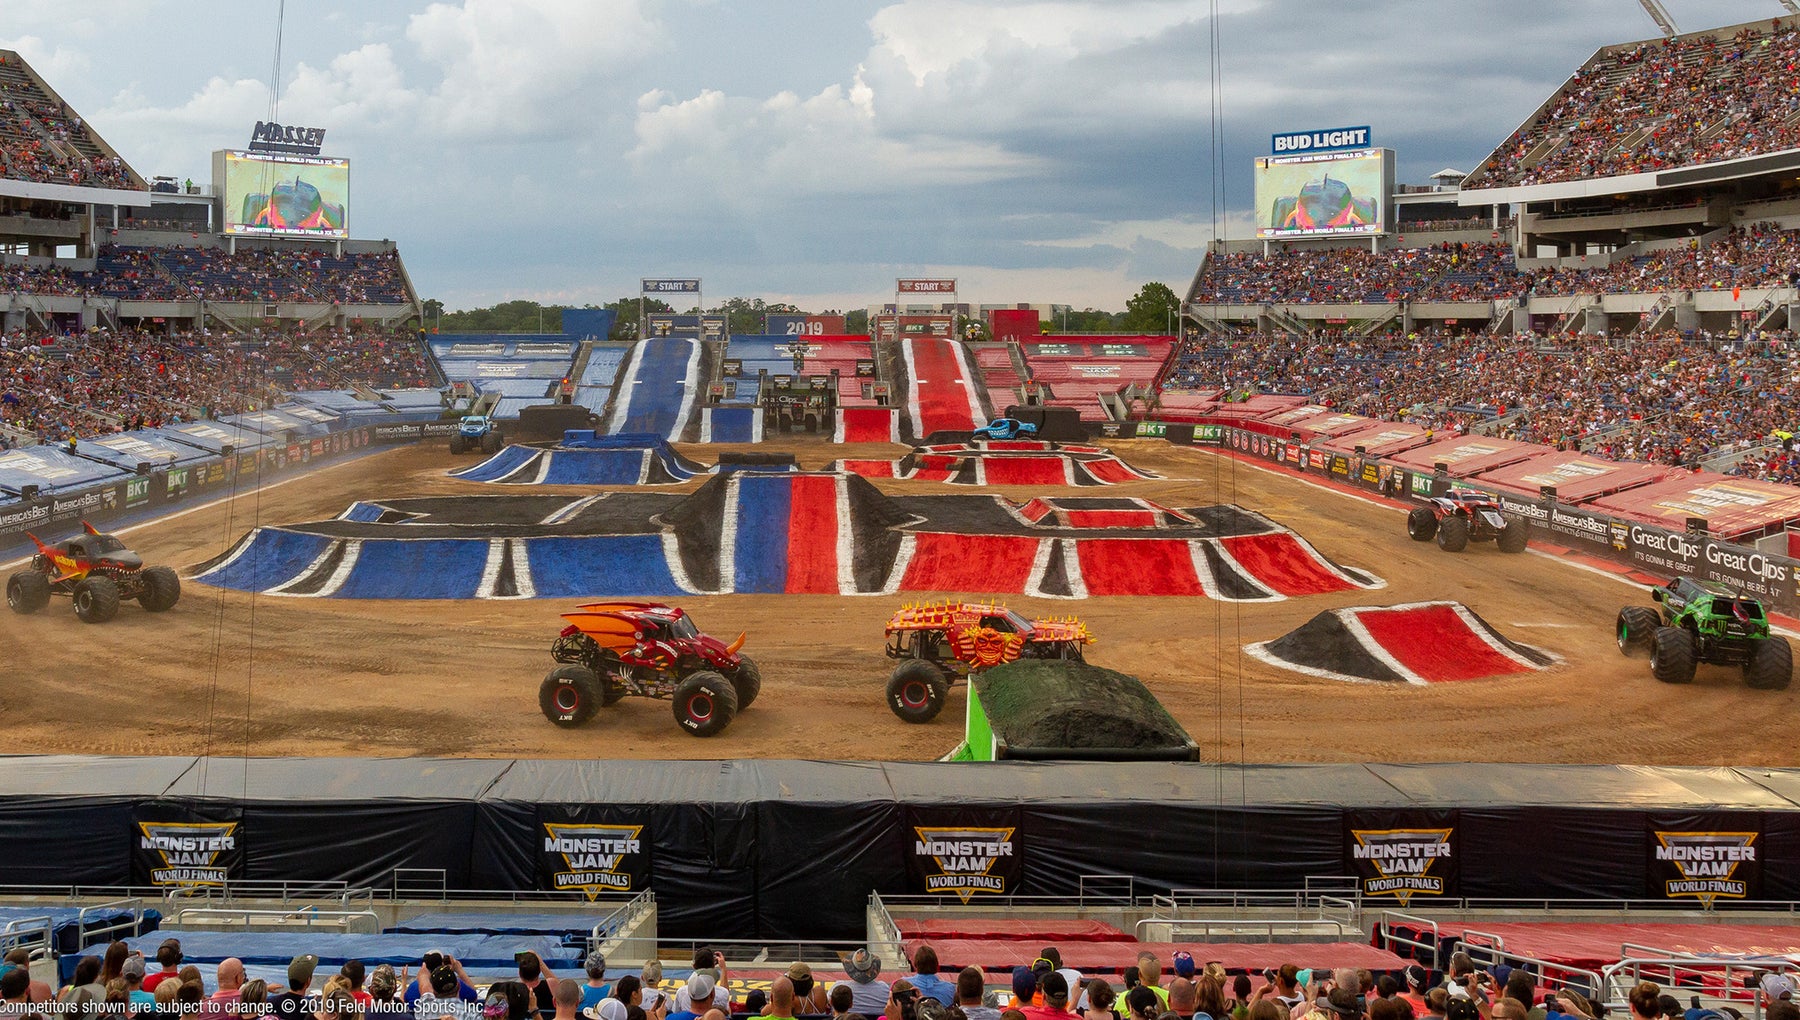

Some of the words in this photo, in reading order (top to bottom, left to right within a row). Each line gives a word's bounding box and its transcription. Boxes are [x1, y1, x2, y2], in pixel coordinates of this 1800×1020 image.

[251, 120, 326, 146] MASSEY
[1275, 135, 1311, 151] BUD
[1313, 129, 1366, 148] LIGHT
[658, 282, 683, 291] START
[914, 282, 939, 291] START
[786, 321, 824, 335] 2019
[1137, 424, 1166, 434] BKT
[1194, 427, 1222, 437] BKT
[168, 471, 188, 488] BKT
[1412, 475, 1433, 492] BKT
[127, 479, 150, 498] BKT
[53, 499, 85, 513] AMERICA'S
[85, 493, 100, 505] BEST
[1501, 497, 1530, 515] AMERICA'S
[1530, 504, 1548, 519] BEST
[32, 506, 50, 518] BEST
[1552, 509, 1587, 528] AMERICA'S
[1587, 517, 1608, 533] BEST
[1551, 524, 1575, 536] CONTACTS
[1631, 526, 1666, 551] Great
[1667, 535, 1698, 561] Clips
[1635, 551, 1644, 561] IT'S
[1645, 554, 1665, 566] GONNA
[1666, 559, 1674, 568] BE
[1675, 562, 1694, 573] GREAT
[1706, 543, 1746, 571] Great
[1749, 554, 1786, 582] Clips
[1709, 571, 1720, 581] IT'S
[1722, 574, 1745, 589] GONNA
[141, 836, 235, 851] MONSTER
[545, 837, 640, 853] MONSTER
[915, 840, 1013, 856] MONSTER
[1353, 842, 1451, 859] MONSTER
[168, 852, 209, 865] JAM
[1656, 845, 1756, 861] MONSTER
[571, 854, 613, 869] JAM
[943, 856, 987, 871] JAM
[1381, 858, 1424, 874] JAM
[1684, 861, 1728, 876] JAM
[154, 869, 190, 882] WORLD
[191, 869, 224, 881] FINALS
[557, 873, 593, 886] WORLD
[594, 873, 628, 886] FINALS
[929, 876, 966, 888] WORLD
[967, 876, 1002, 889] FINALS
[1368, 877, 1404, 891] WORLD
[1405, 879, 1440, 890] FINALS
[1669, 881, 1707, 893] WORLD
[1708, 881, 1743, 894] FINALS
